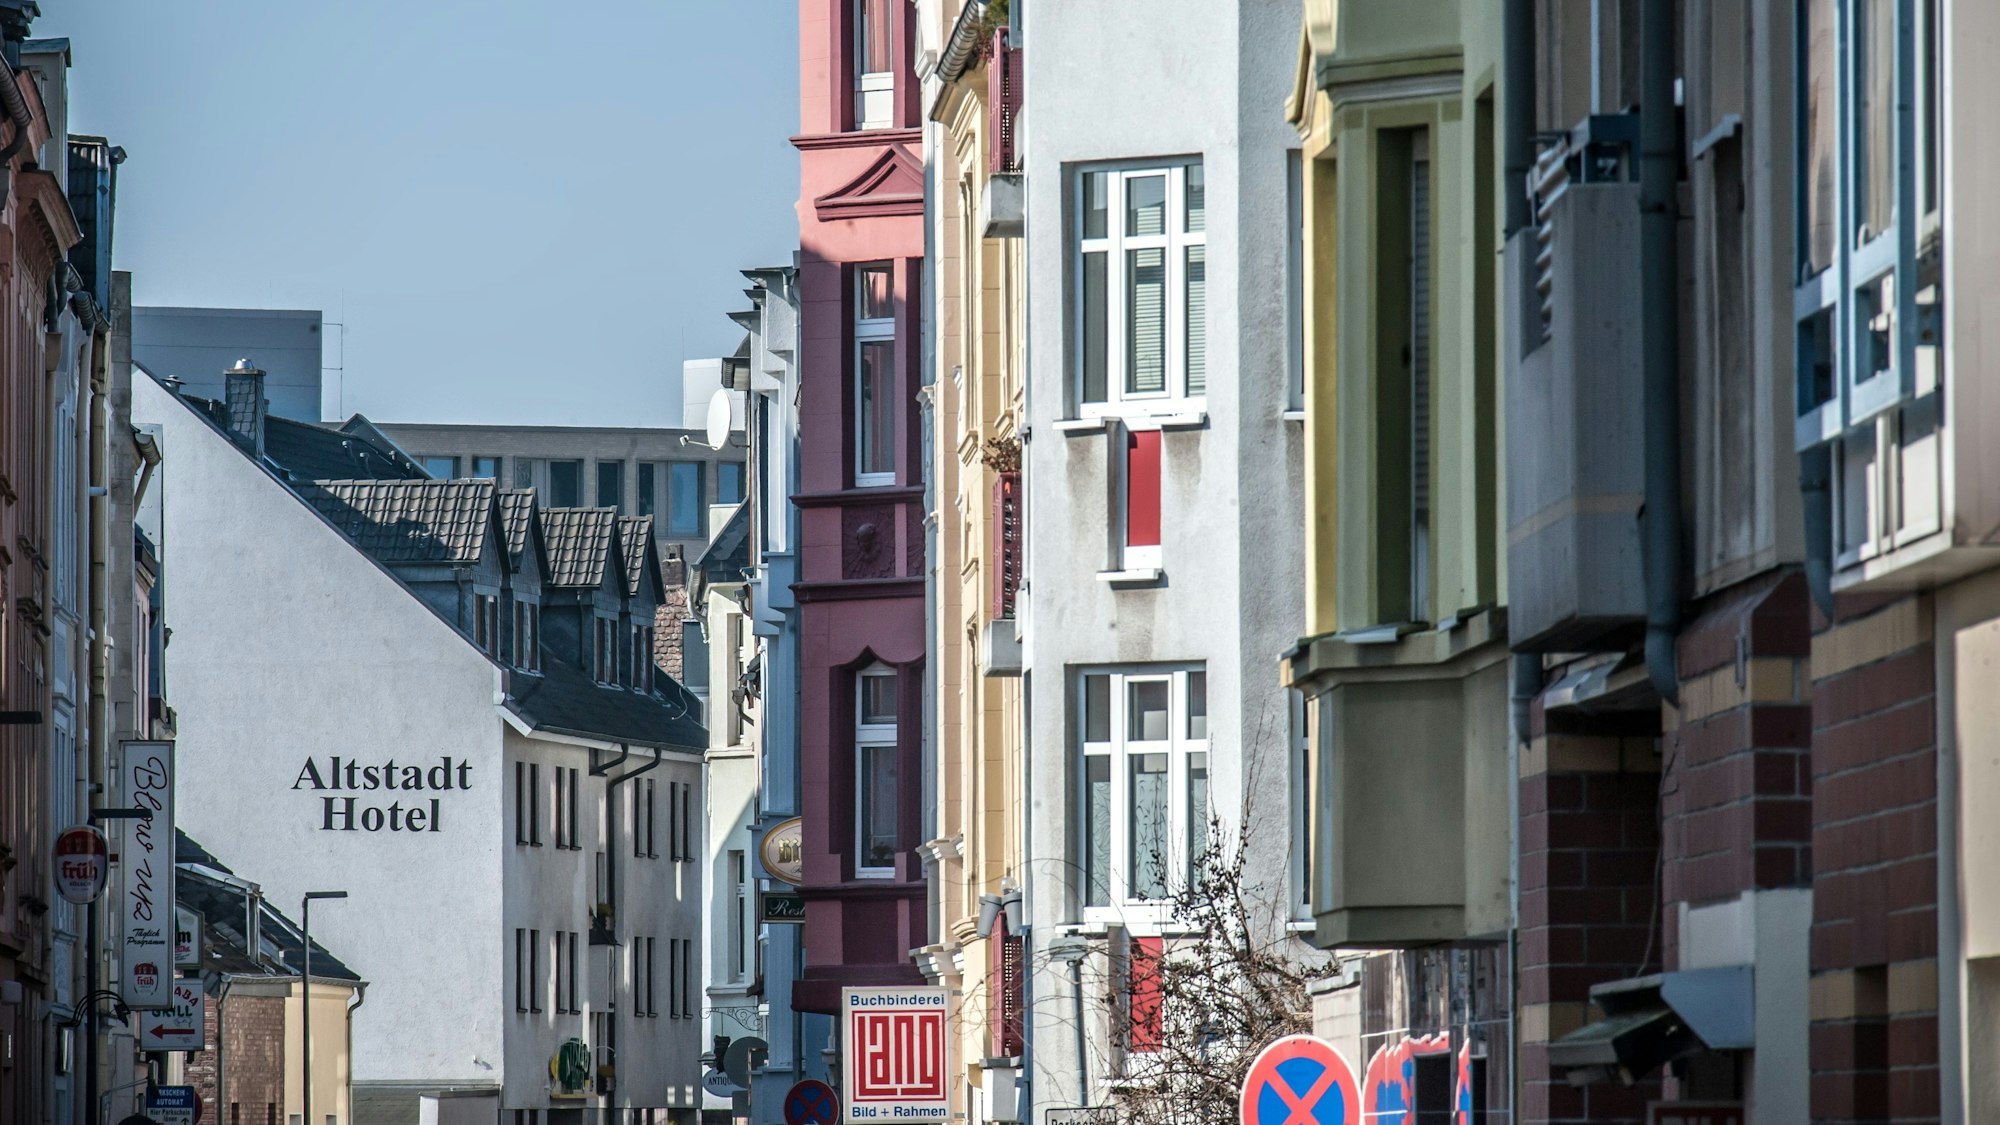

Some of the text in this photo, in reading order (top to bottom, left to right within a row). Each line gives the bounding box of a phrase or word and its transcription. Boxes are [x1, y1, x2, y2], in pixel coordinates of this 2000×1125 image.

[291, 756, 473, 790] Altstadt
[319, 796, 442, 832] Hotel
[62, 860, 98, 880] früh
[132, 928, 160, 939] Täglich
[126, 936, 165, 949] Programm
[137, 976, 154, 986] früh
[850, 994, 945, 1006] Buchbinderei
[708, 1076, 732, 1088] ANTIQ
[852, 1106, 946, 1117] Bild + Rahmen
